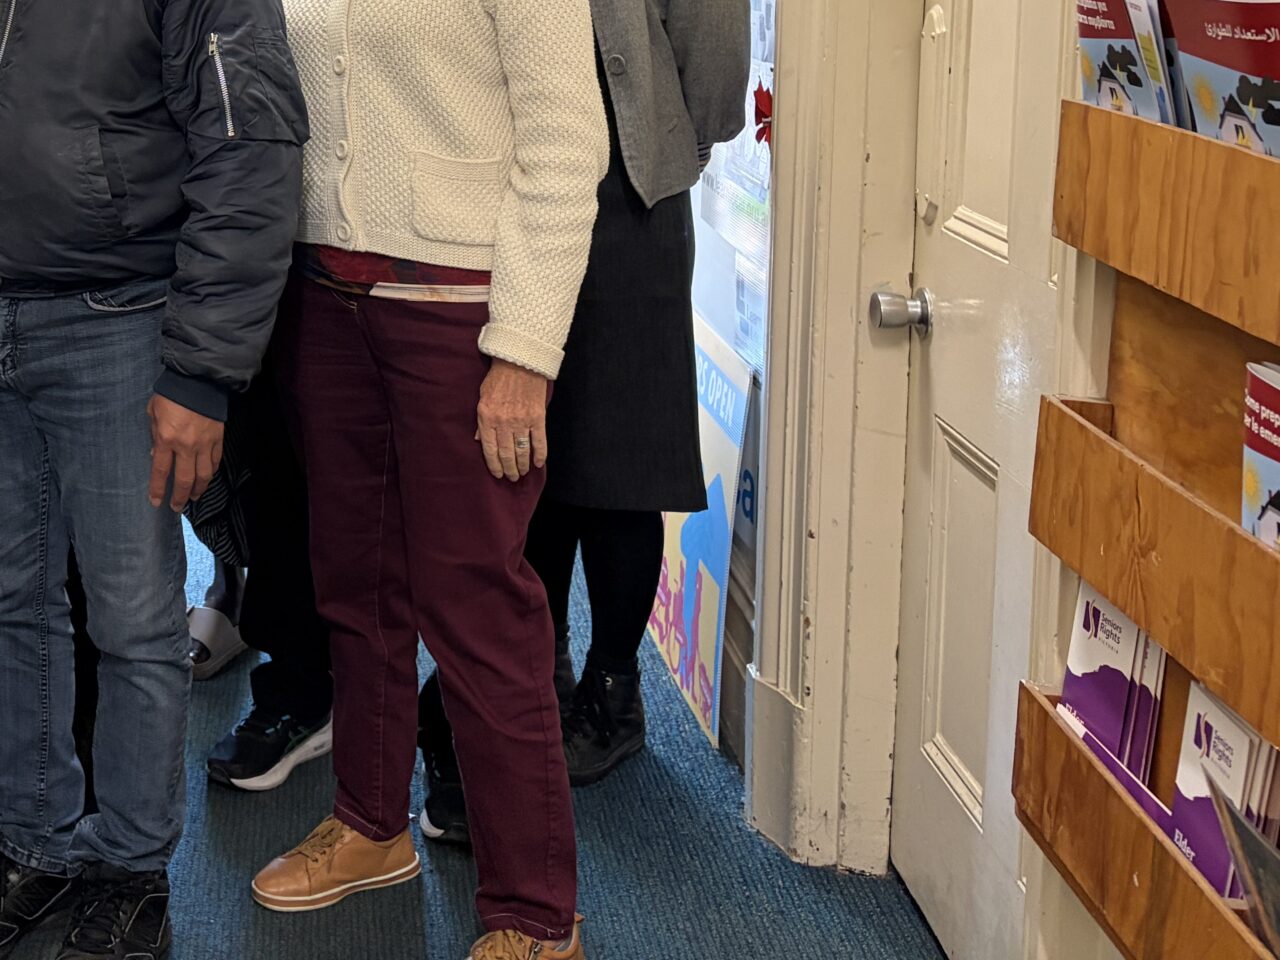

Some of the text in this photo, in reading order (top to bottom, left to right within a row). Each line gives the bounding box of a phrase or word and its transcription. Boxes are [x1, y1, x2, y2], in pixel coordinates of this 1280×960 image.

[708, 369, 736, 427] OPEN
[1261, 405, 1280, 427] prep
[1100, 622, 1120, 644] Rights
[1101, 613, 1122, 634] Seniors
[1212, 740, 1232, 768] Rights
[1214, 729, 1234, 756] Seniors
[1174, 828, 1196, 861] Elder
